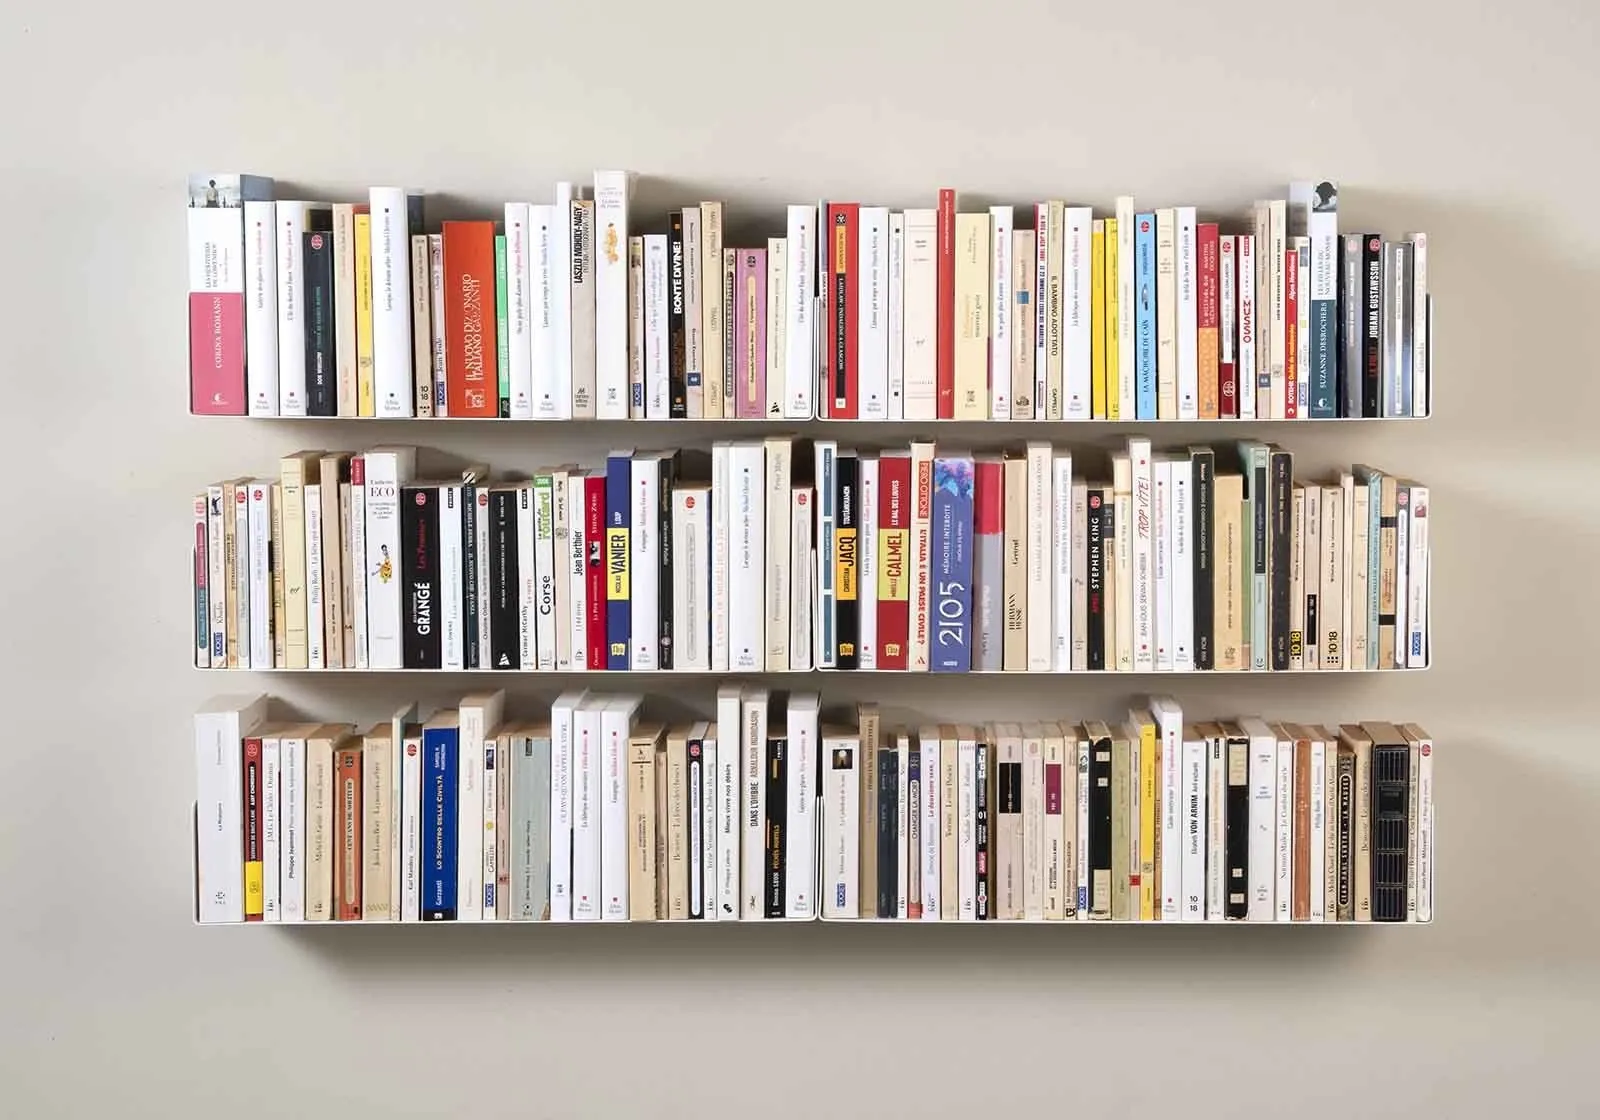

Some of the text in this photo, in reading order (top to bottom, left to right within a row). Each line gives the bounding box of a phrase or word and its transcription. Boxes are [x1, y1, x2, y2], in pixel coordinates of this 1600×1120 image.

[573, 207, 583, 283] LASZLO MOHOLY-NAGY
[673, 241, 681, 278] DIVINE!
[1370, 260, 1379, 338] JOHANA GUSTAWSSON
[213, 297, 223, 368] CORINA ROMANN
[1319, 302, 1328, 388] SUZANNE DESROCHERS
[463, 334, 474, 369] NUOVO
[370, 487, 395, 497] ECO
[614, 511, 622, 525] LOUP
[1091, 517, 1099, 542] KING
[1138, 509, 1149, 539] TROP
[573, 530, 583, 576] Jean Berthier
[611, 535, 625, 575] VANIER
[839, 537, 856, 567] JACQ
[887, 533, 902, 577] CALMEL
[943, 539, 951, 574] MÉMOIRE
[1091, 546, 1099, 589] STEPHEN
[540, 575, 551, 615] Corse
[919, 572, 926, 585] UN
[415, 582, 430, 635] GRANGÉ
[939, 581, 964, 646] 2105
[1008, 593, 1016, 630] HERMANN
[917, 613, 925, 645] CIVILE?
[1291, 632, 1301, 656] 10 18
[1328, 631, 1338, 654] 10 18
[750, 810, 759, 826] DANS
[1190, 794, 1198, 818] ARNIM
[1341, 861, 1349, 903] JEAN-PAUL
